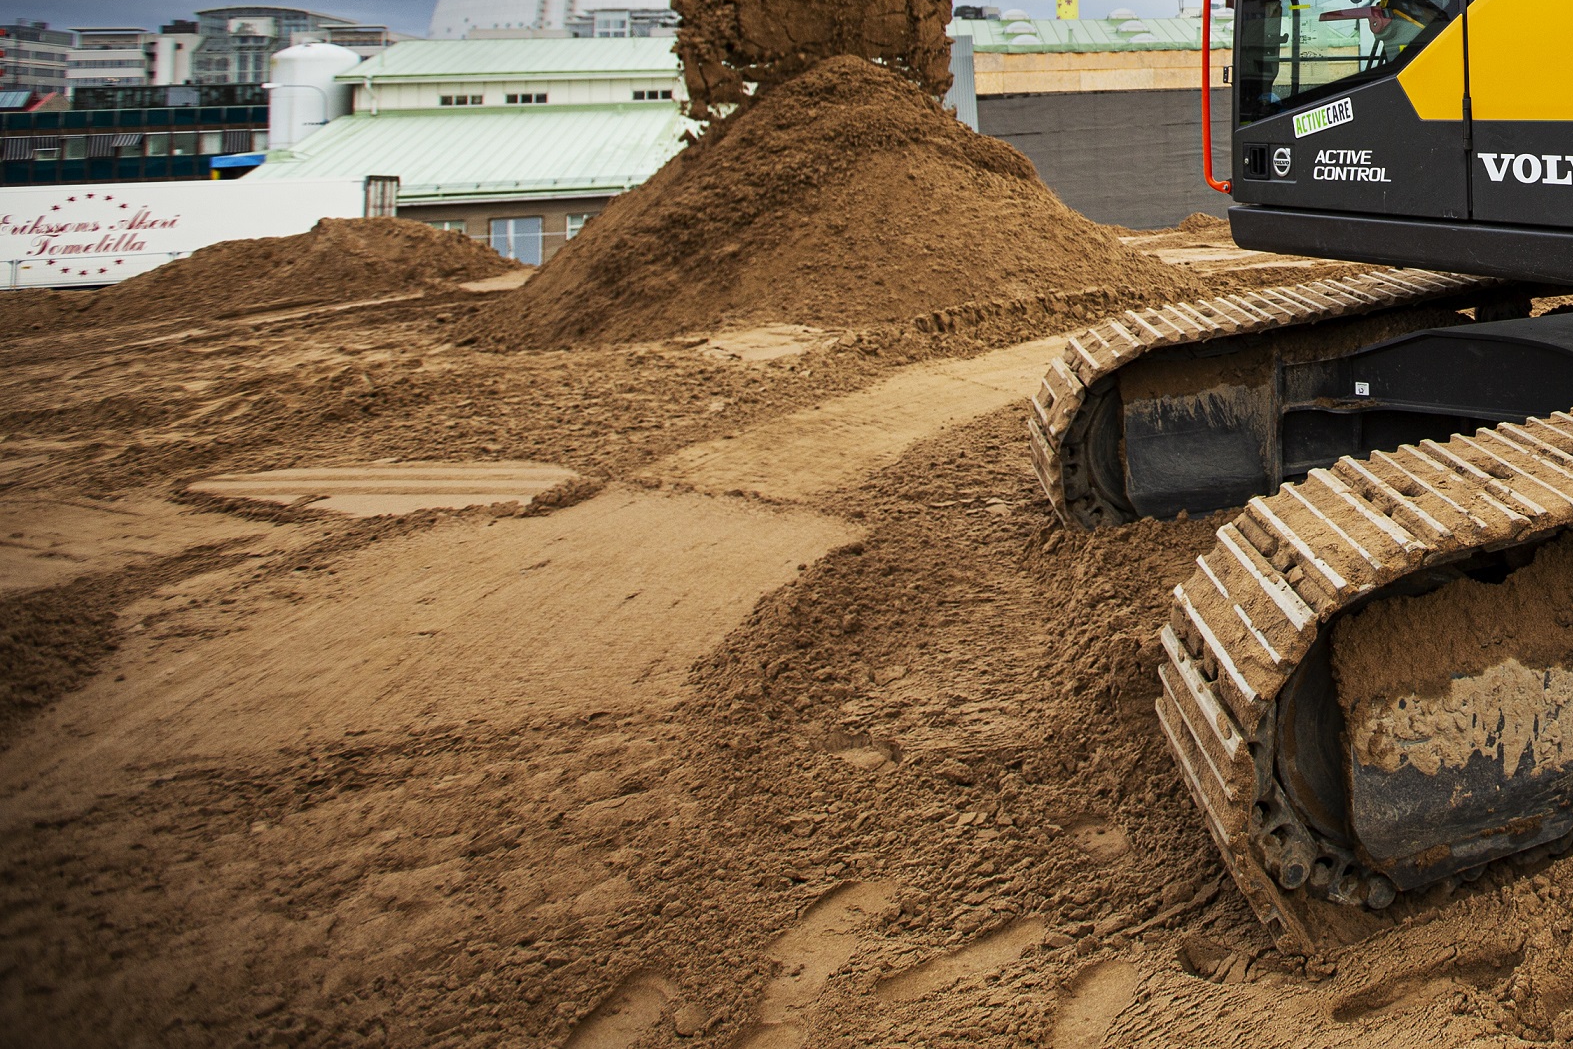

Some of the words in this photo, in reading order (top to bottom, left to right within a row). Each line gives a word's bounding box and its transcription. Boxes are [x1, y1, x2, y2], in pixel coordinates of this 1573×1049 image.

[1314, 149, 1373, 165] ACTIVE
[1313, 166, 1392, 183] CONTROL
[0, 214, 101, 236] Erikssons
[26, 233, 149, 256] Tomelilla
